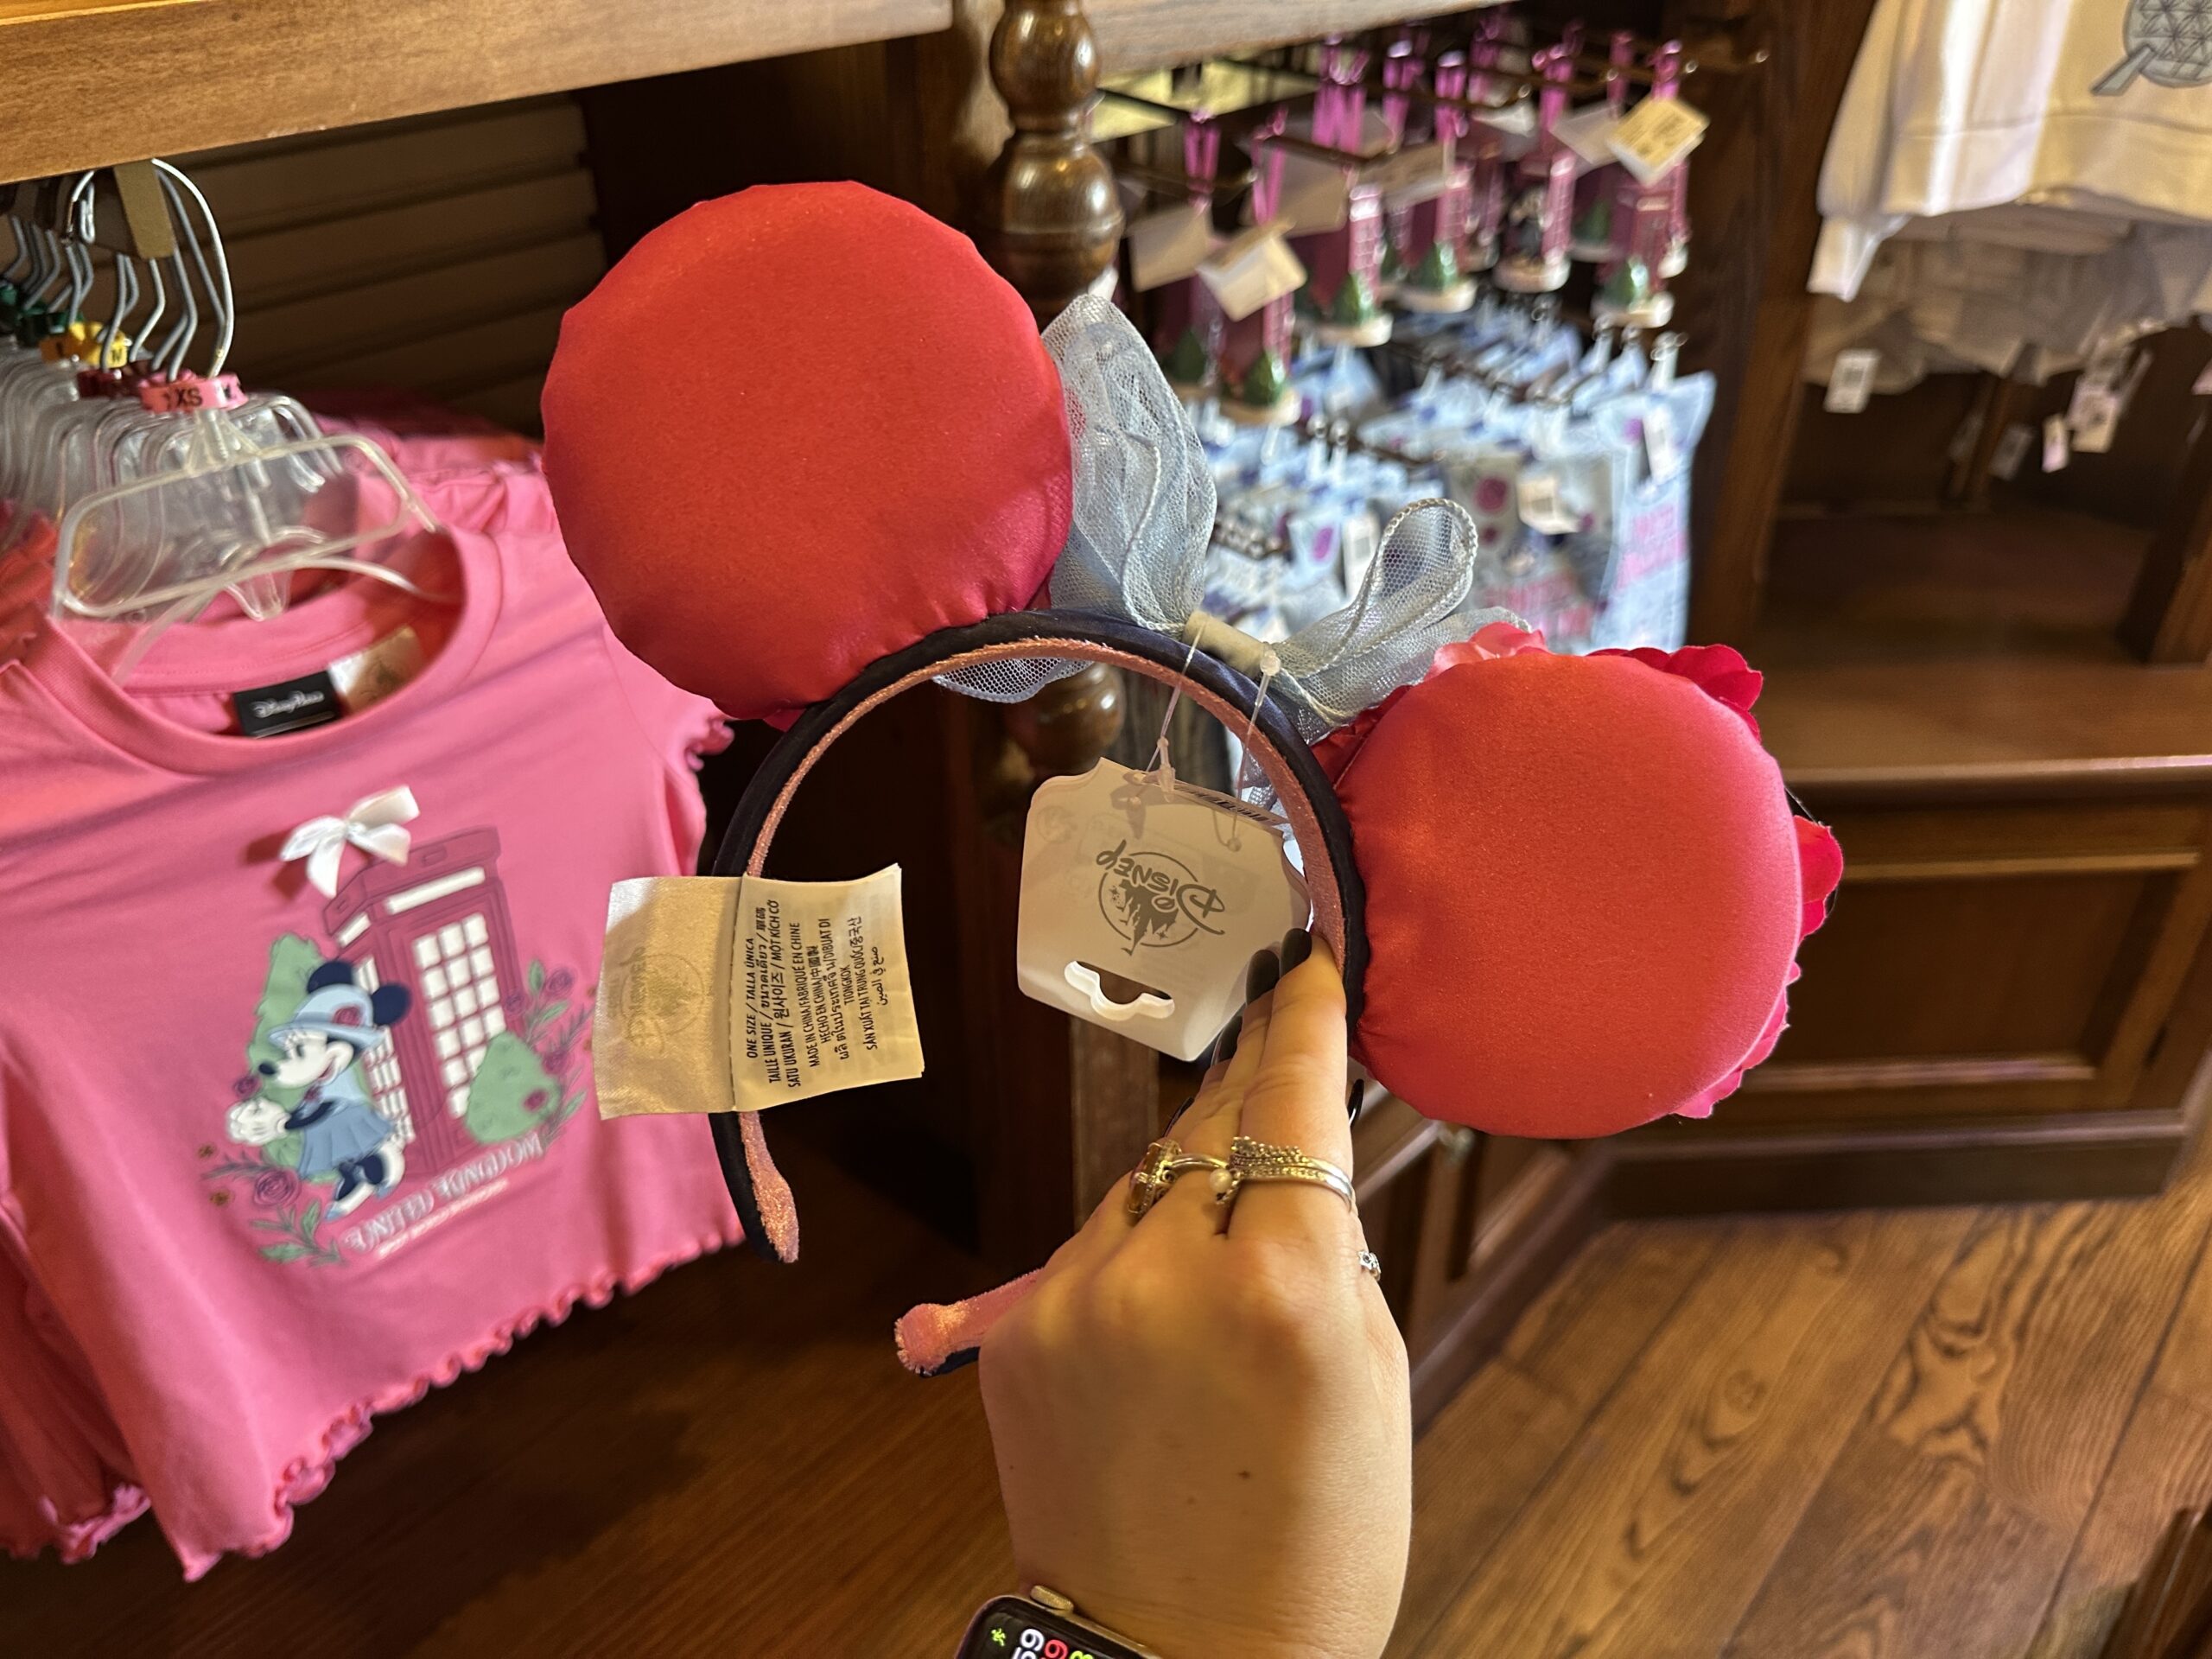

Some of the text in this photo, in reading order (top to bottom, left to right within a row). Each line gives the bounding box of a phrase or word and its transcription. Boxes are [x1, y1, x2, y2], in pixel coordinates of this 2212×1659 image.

[767, 917, 780, 938] KÍCH
[818, 918, 830, 927] DI
[790, 923, 802, 950] CHINE
[744, 938, 754, 968] ÚNICA
[791, 952, 803, 963] EN
[746, 972, 755, 1001] TALLA
[840, 965, 855, 1005] TIONGKOK
[855, 969, 868, 995] TRUNG
[817, 1004, 827, 1014] EN
[747, 1014, 756, 1035] SIZE
[817, 1015, 831, 1043] HECHO
[747, 1039, 758, 1058] ONE
[760, 1022, 776, 1056] UNIQUE
[779, 1031, 797, 1065] UKURAN
[804, 1033, 816, 1042] IN
[806, 1043, 820, 1067] MADE
[765, 1058, 781, 1083] TAILLE
[785, 1068, 801, 1087] SATU
